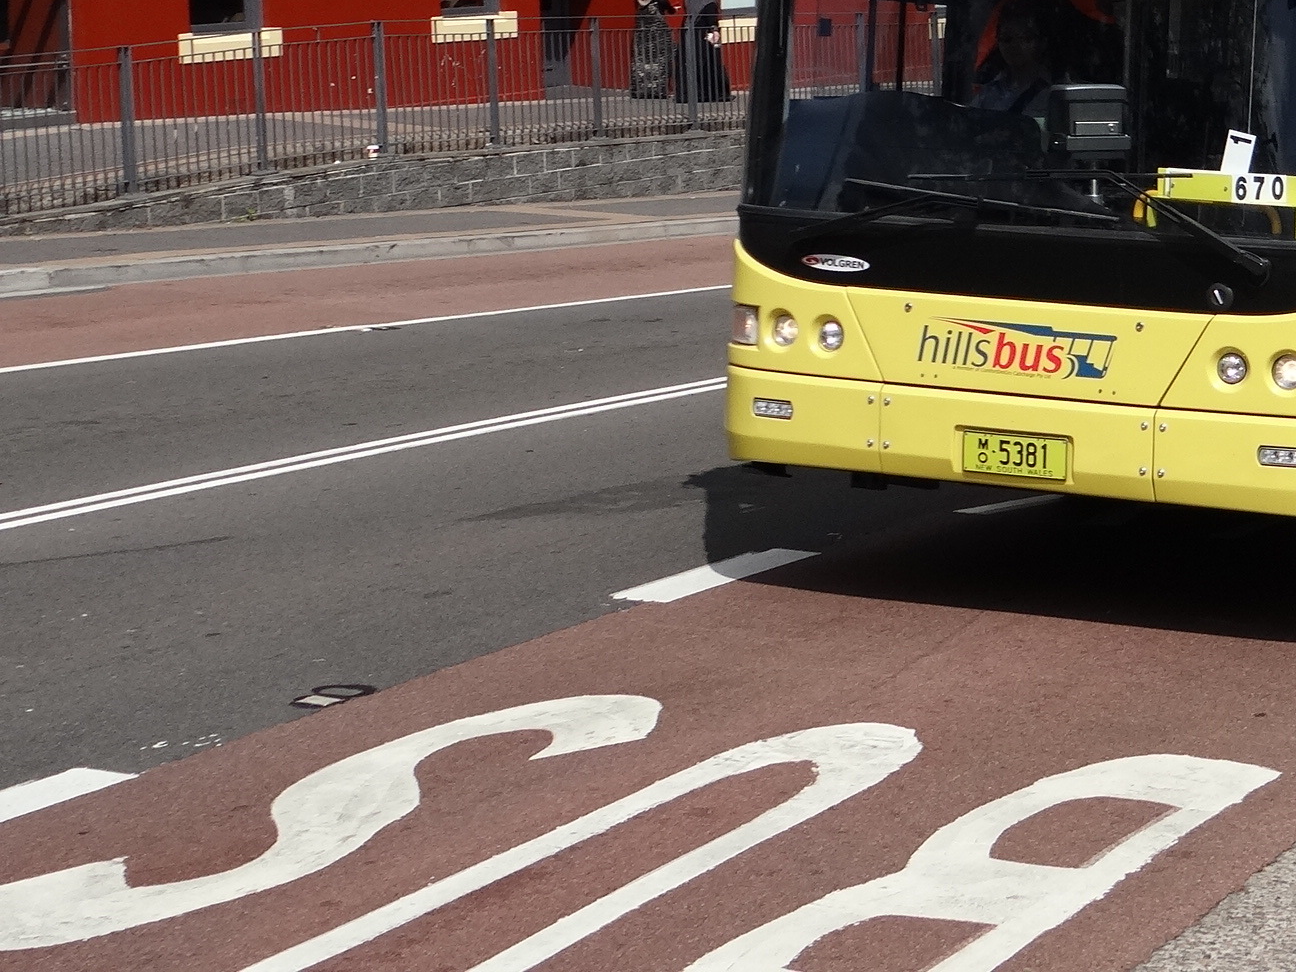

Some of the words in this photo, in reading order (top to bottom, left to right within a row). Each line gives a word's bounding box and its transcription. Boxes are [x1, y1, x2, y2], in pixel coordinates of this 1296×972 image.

[1235, 176, 1284, 200] 670
[819, 257, 865, 269] VOLGREN
[917, 325, 1065, 374] hillsbus
[999, 439, 1048, 469] 5381
[975, 463, 992, 471] NEW
[996, 465, 1023, 474] SOUTH
[1027, 469, 1053, 477] WALES
